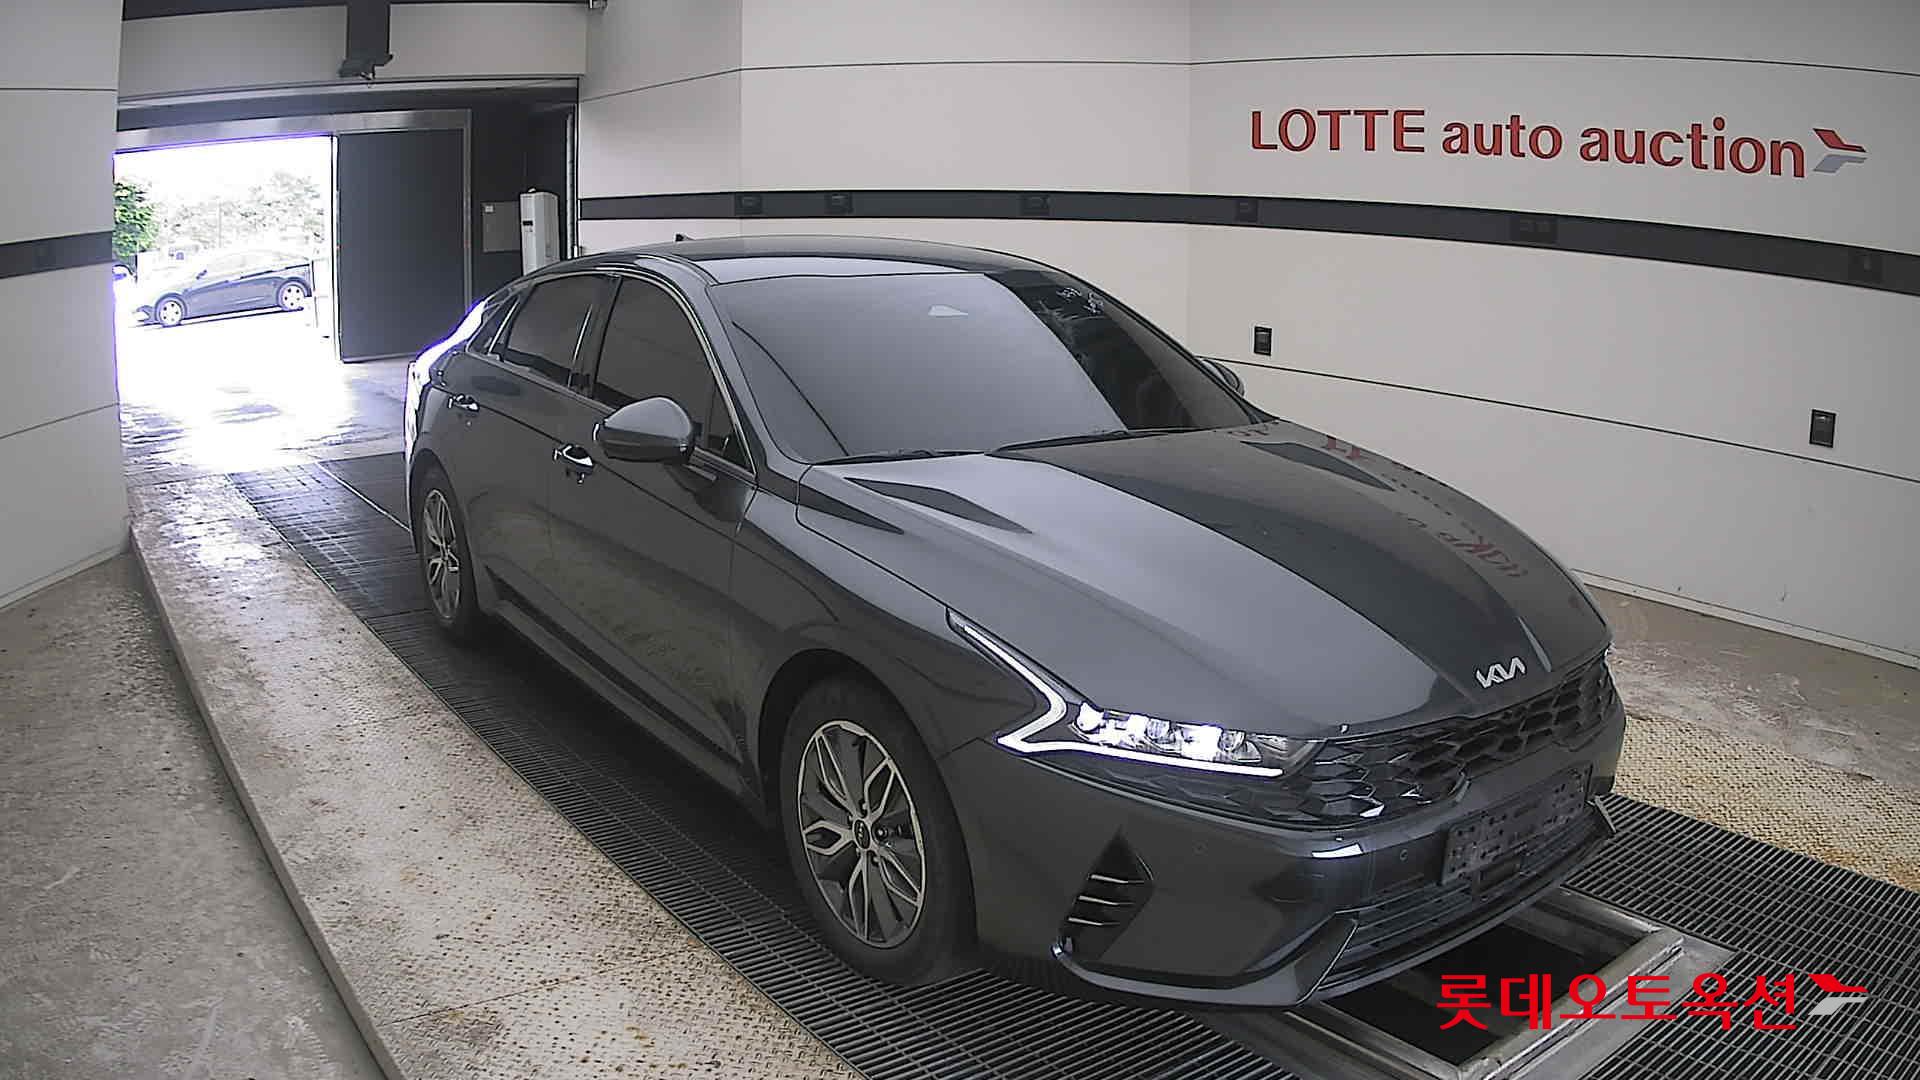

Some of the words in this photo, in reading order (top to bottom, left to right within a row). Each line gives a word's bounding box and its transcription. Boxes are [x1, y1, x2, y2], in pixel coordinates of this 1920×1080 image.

[1252, 109, 1426, 153] LOTTE
[1442, 114, 1563, 160] auto
[1580, 116, 1807, 179] auction
